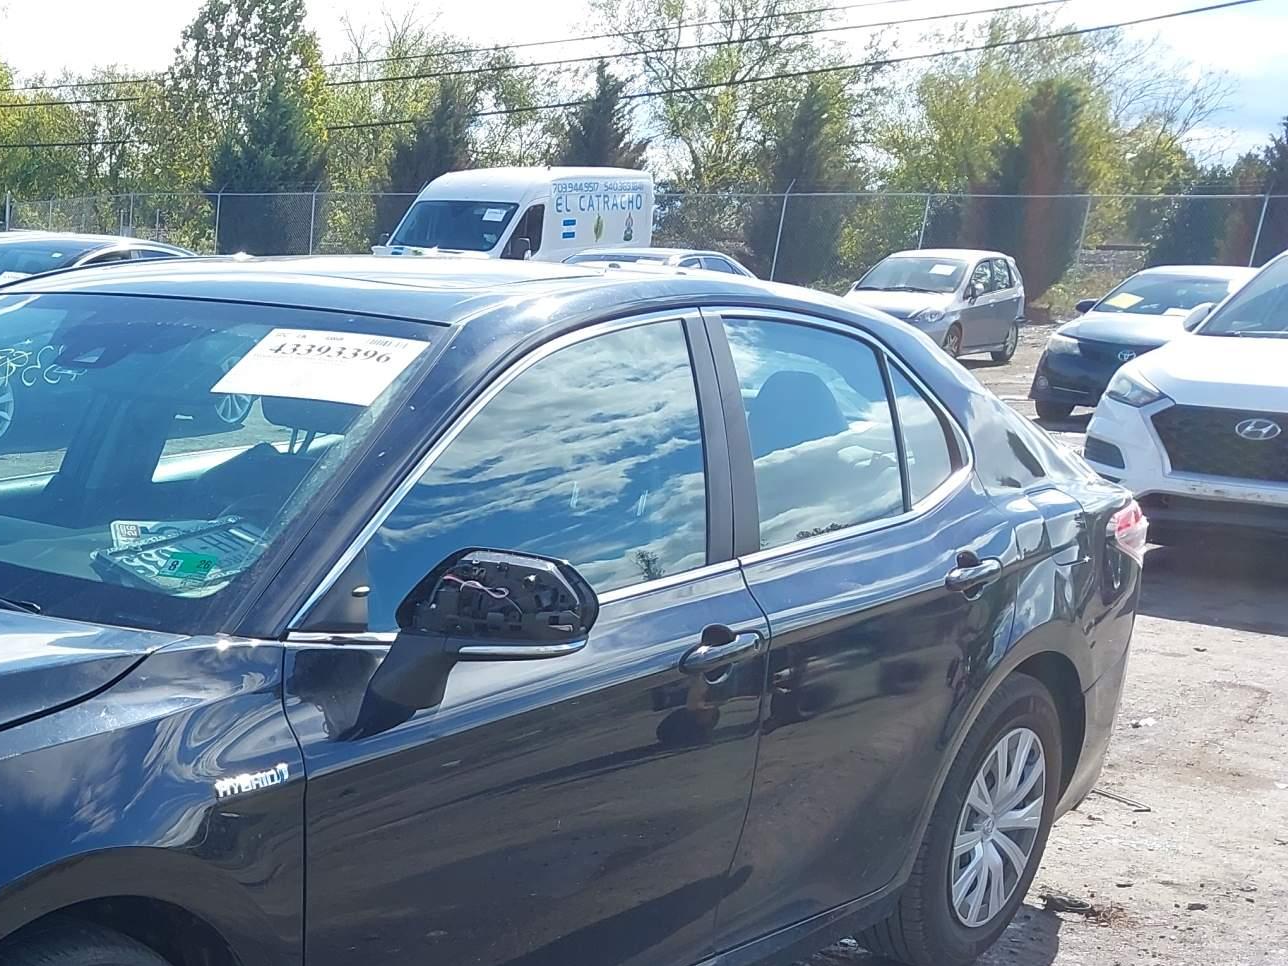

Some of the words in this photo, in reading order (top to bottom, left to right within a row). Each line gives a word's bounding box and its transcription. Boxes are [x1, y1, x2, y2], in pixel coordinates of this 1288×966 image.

[555, 196, 571, 213] EL
[578, 194, 643, 212] CATRACHO
[268, 342, 392, 364] 43393396
[215, 763, 289, 798] HYBRID
